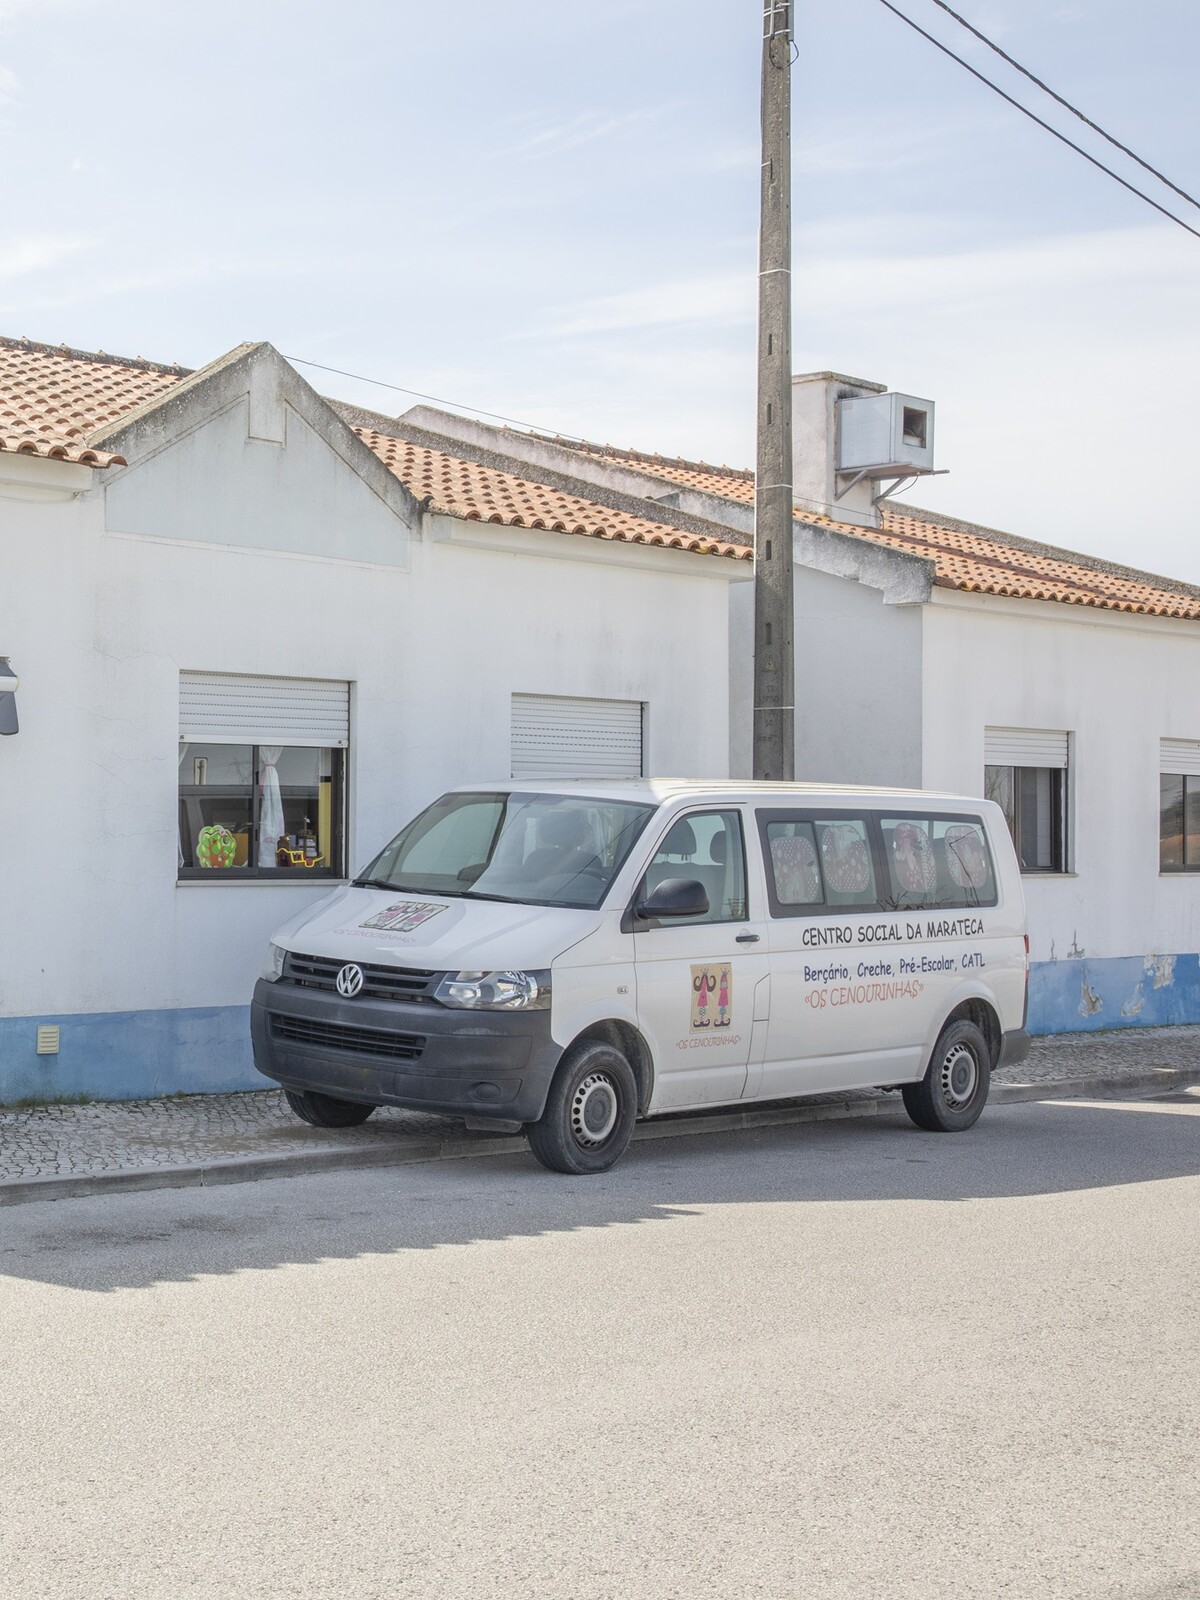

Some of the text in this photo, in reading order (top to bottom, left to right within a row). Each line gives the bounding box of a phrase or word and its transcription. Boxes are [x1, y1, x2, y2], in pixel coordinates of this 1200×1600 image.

[802, 919, 984, 946] CENTRO SOCIAL DA MARATECA
[804, 952, 986, 984] Berçário, Creche, Pré-Escolar, CATL
